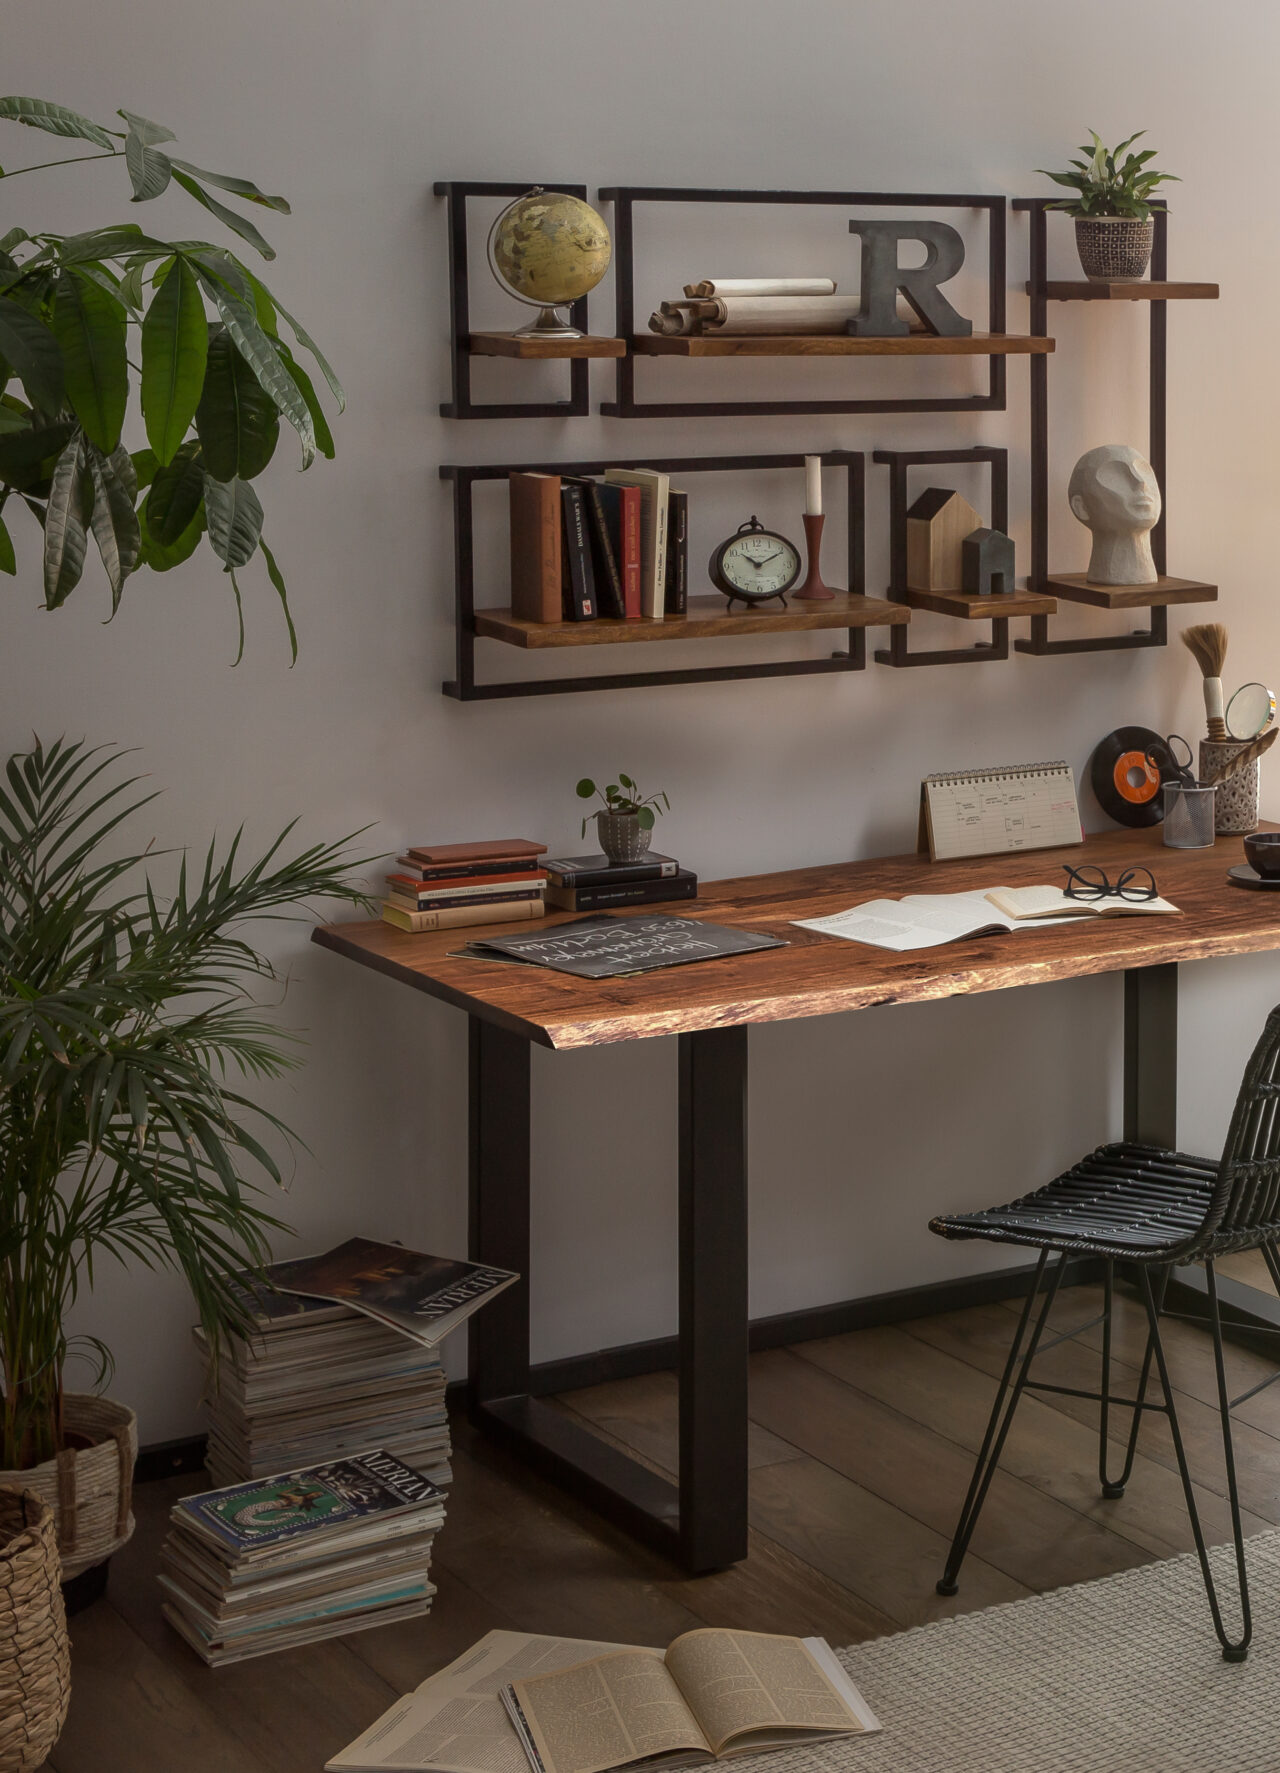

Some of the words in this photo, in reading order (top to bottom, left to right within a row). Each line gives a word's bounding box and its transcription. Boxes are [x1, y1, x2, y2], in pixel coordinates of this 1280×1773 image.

[848, 219, 973, 336] R
[729, 549, 738, 557] 10
[741, 542, 748, 550] 11
[752, 539, 762, 547] 12
[606, 940, 719, 964] Herbert
[413, 1269, 512, 1319] MERIAN
[357, 1452, 440, 1501] MERIAN
